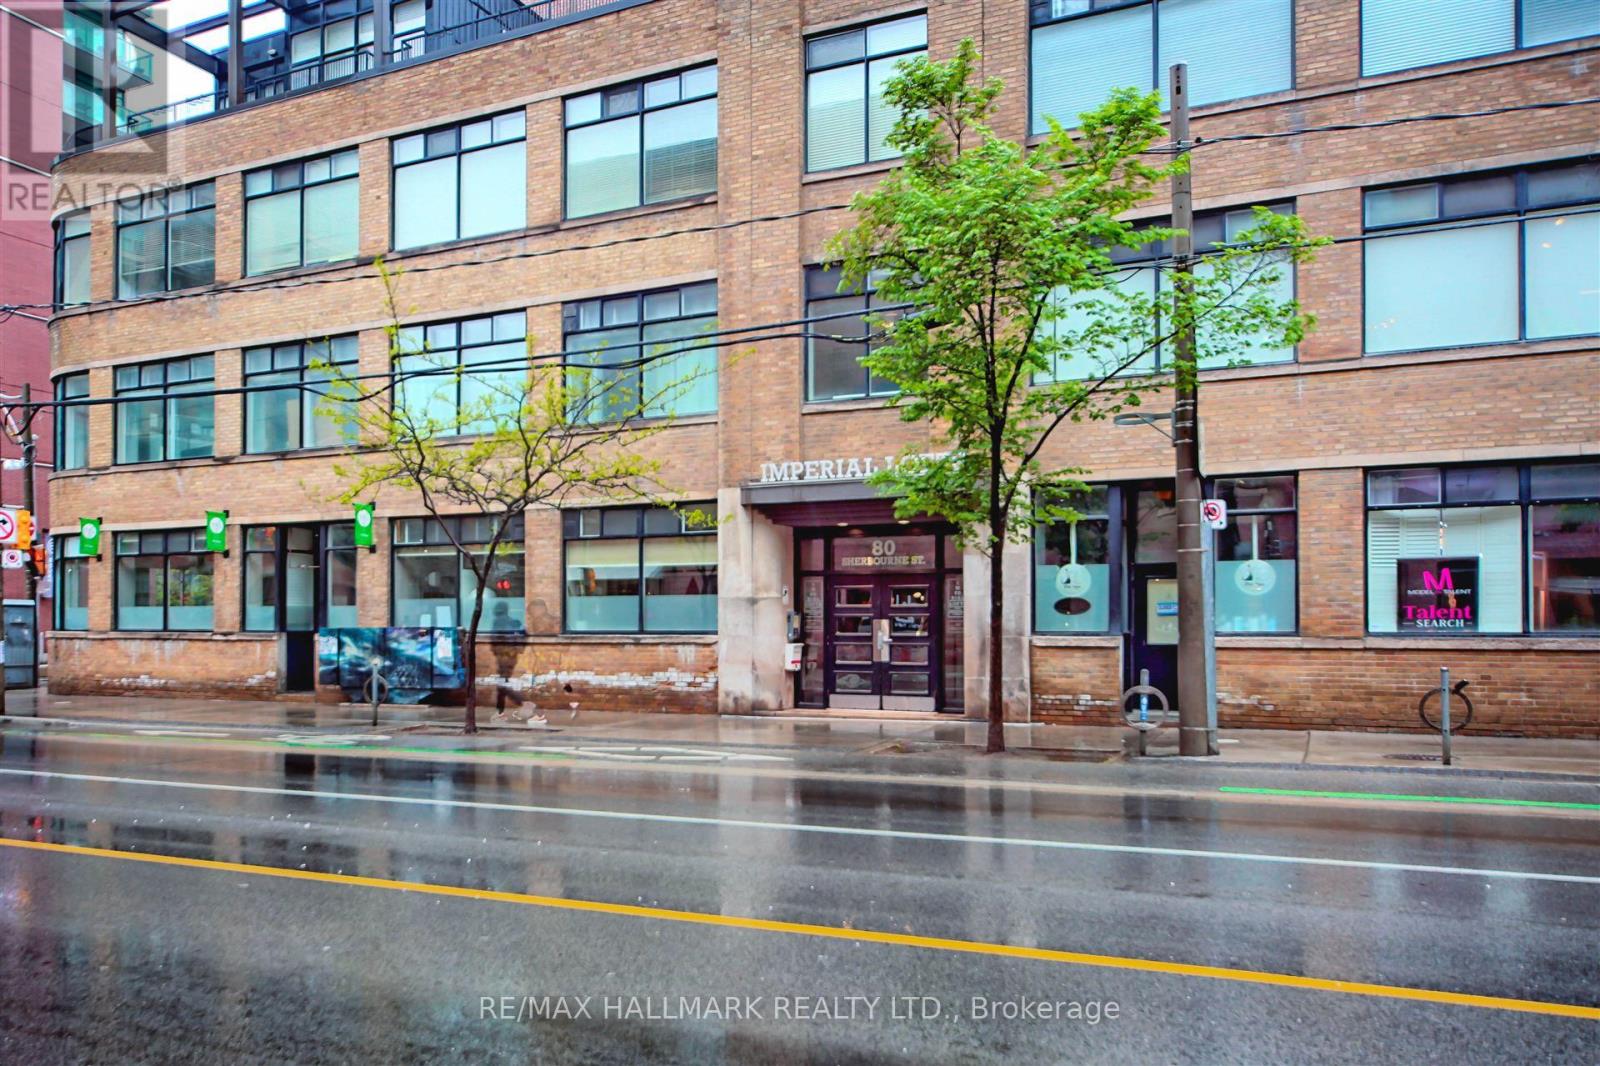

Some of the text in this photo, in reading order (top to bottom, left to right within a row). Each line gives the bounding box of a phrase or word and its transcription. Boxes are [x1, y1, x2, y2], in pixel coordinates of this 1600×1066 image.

[760, 451, 967, 483] IMPERIAL LOS
[872, 540, 896, 556] 80
[842, 556, 909, 566] SHERBOURNE
[1423, 567, 1454, 590] M
[1403, 605, 1471, 619] Talent
[1416, 619, 1464, 627] SEARCH
